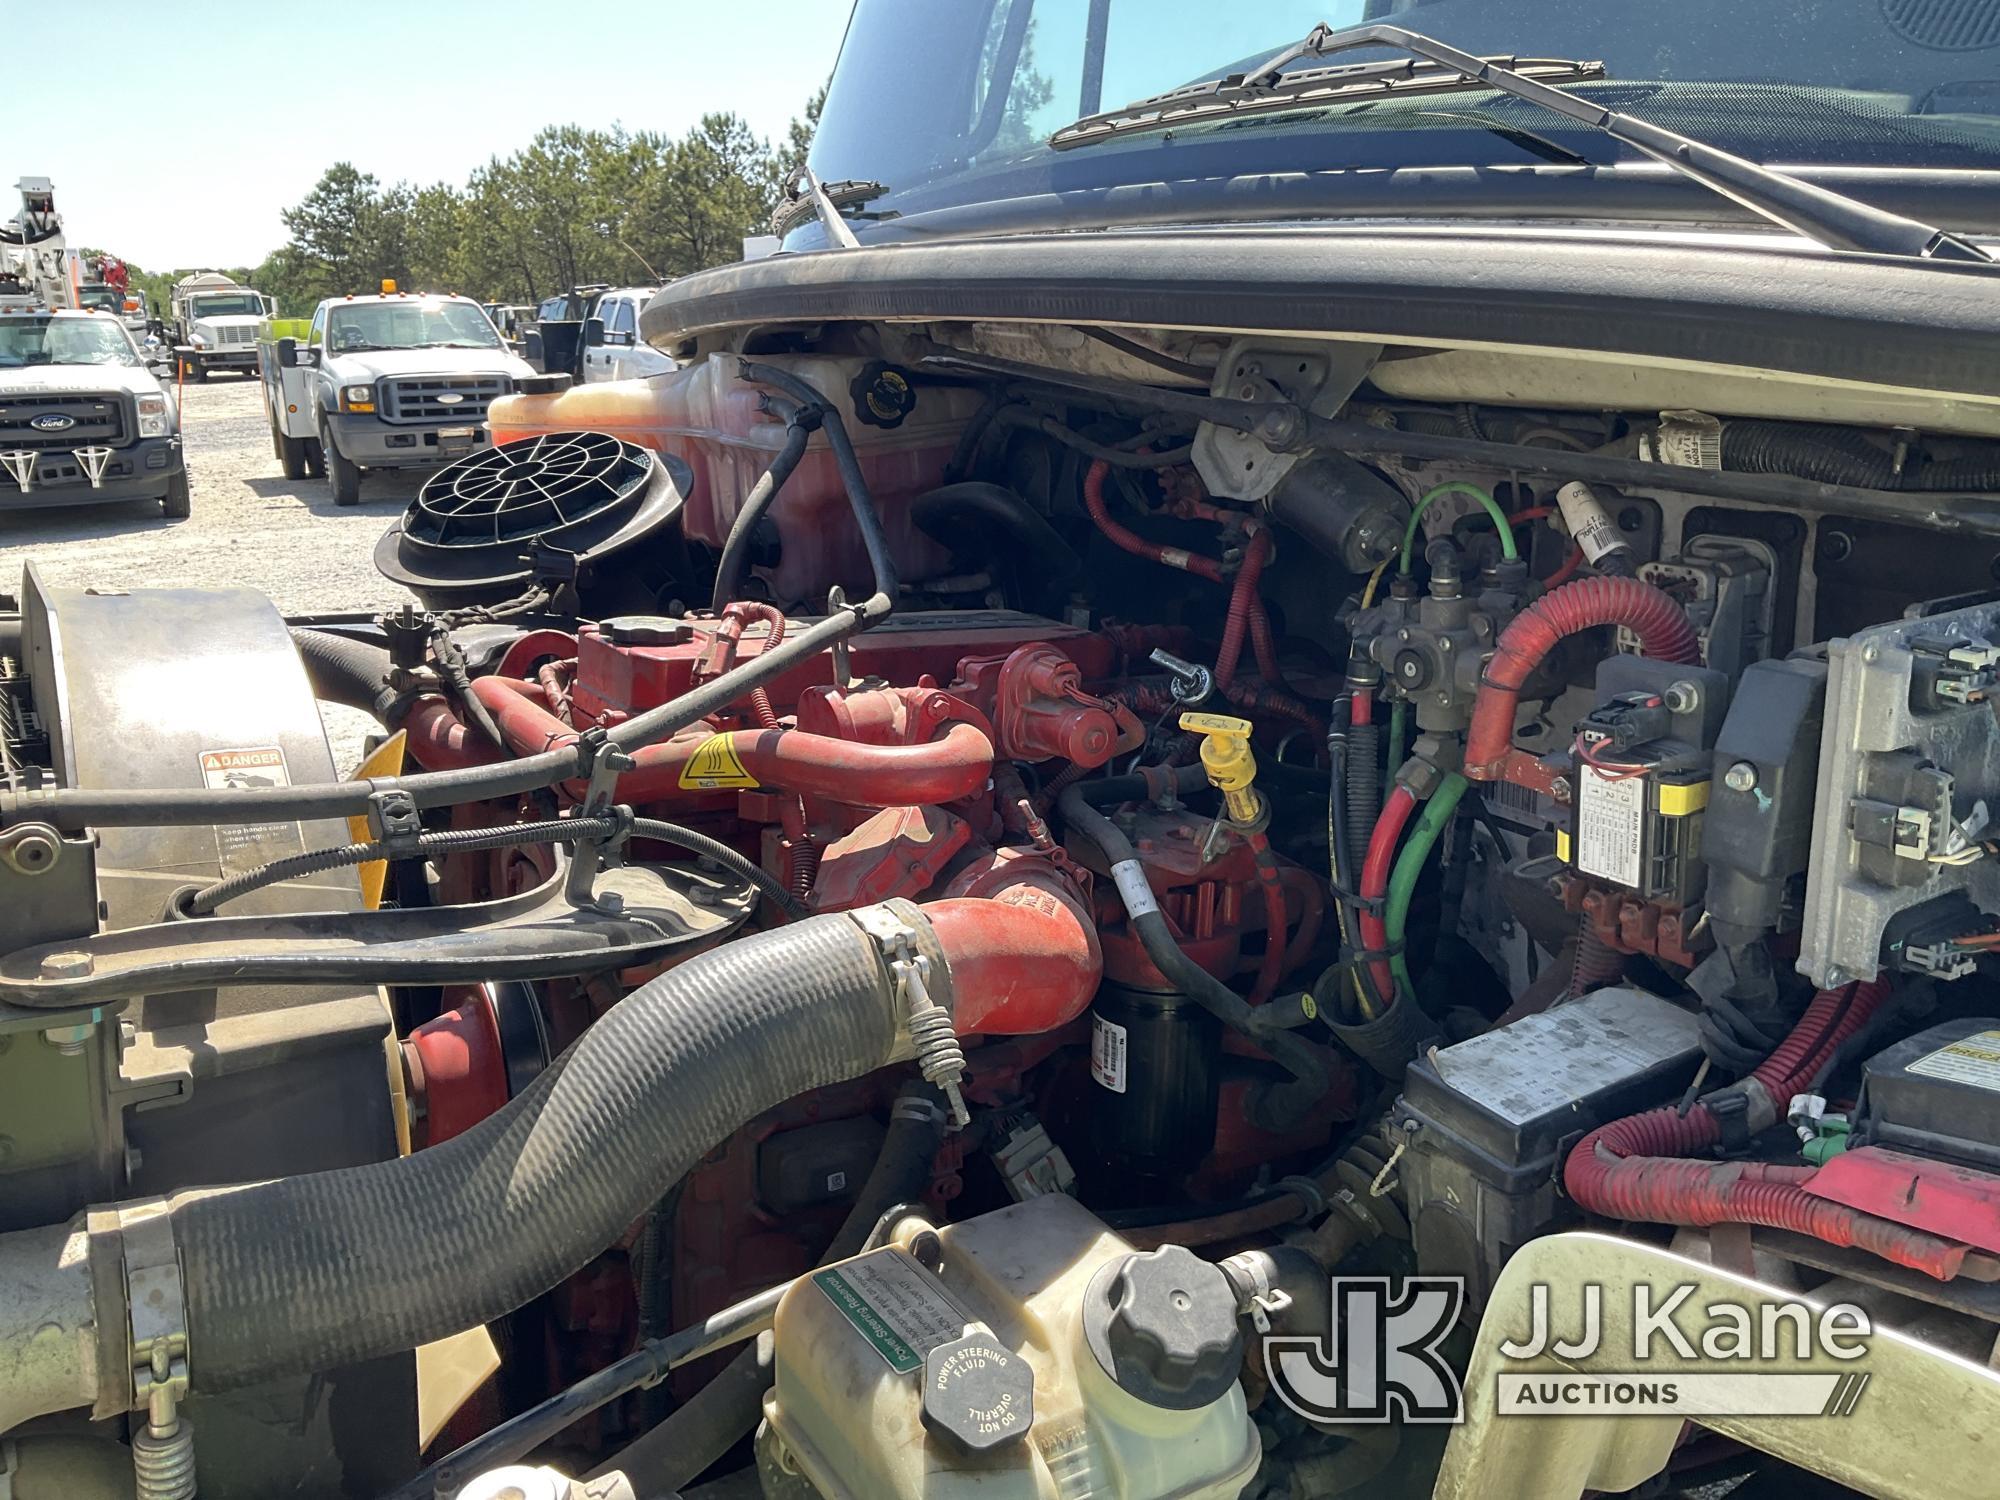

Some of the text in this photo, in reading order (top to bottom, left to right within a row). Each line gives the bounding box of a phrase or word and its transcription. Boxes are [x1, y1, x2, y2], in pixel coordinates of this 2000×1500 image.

[40, 418, 64, 427] Ford
[221, 753, 280, 766] DANGER
[1621, 794, 1631, 802] 3
[243, 826, 268, 834] hands
[825, 1276, 911, 1362] Power Steering Reservoir
[938, 1347, 1008, 1390] POWER STEERING
[953, 1359, 986, 1377] FLUID
[968, 1393, 1012, 1421] OVERFILL
[978, 1412, 1016, 1433] DO NOT
